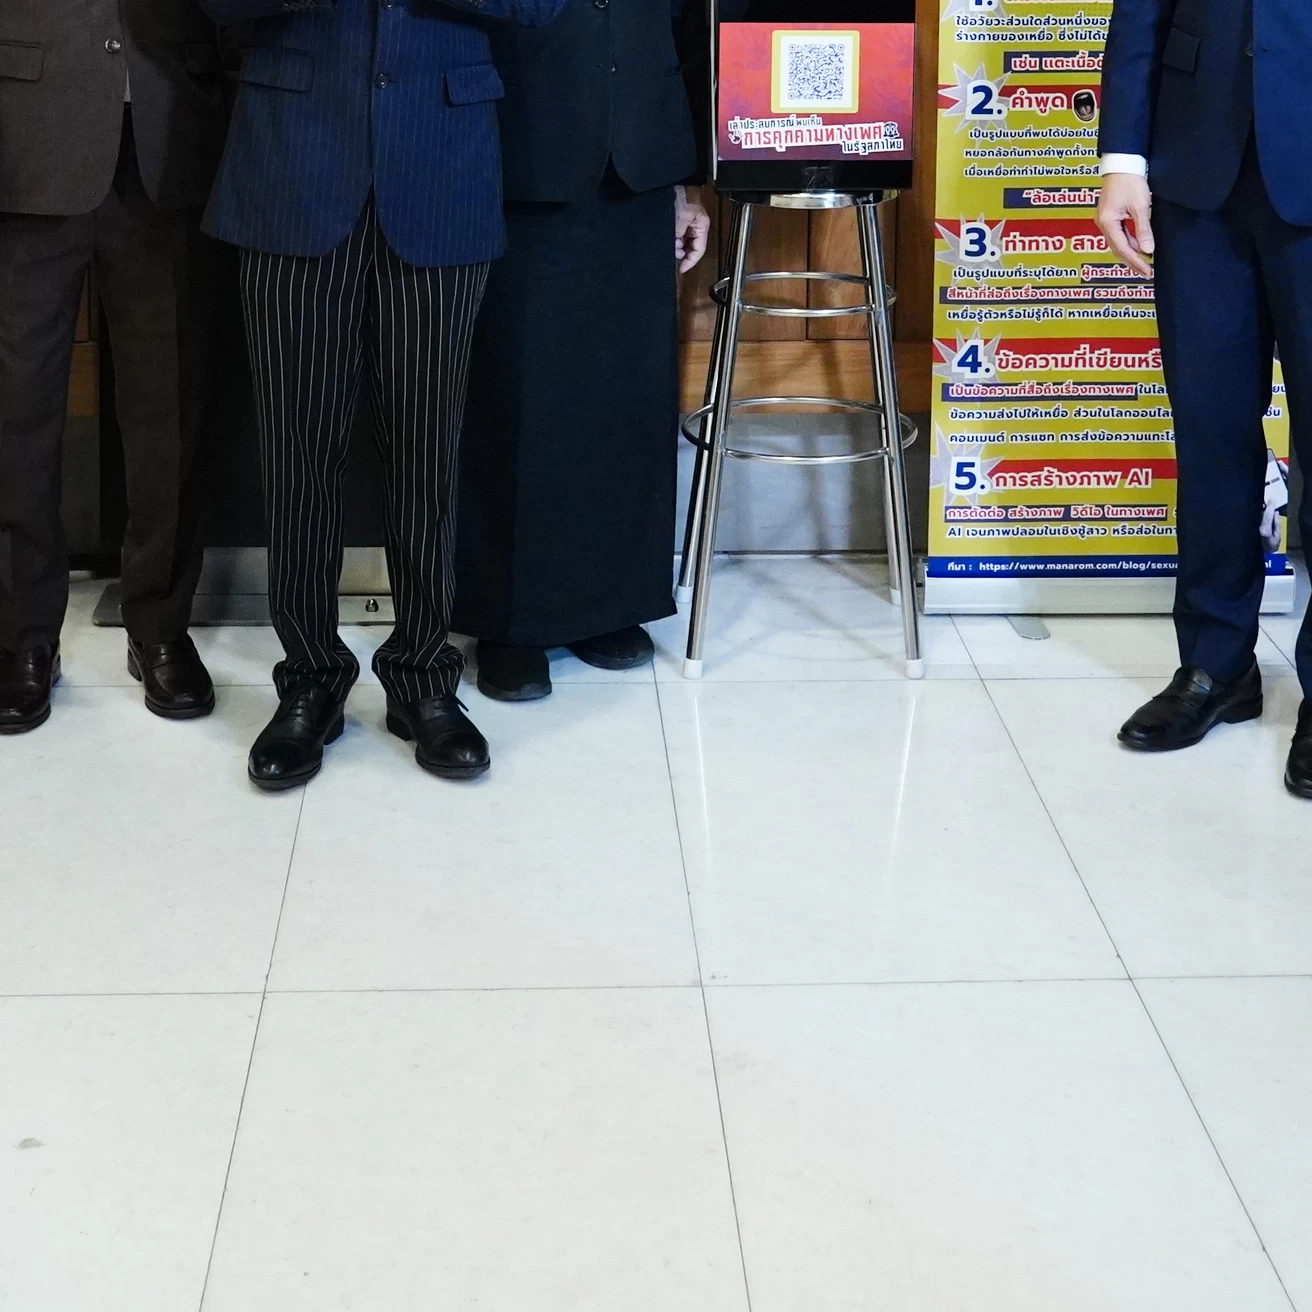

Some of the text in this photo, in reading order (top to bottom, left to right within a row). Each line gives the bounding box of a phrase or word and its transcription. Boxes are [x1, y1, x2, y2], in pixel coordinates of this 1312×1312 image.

[956, 29, 1053, 41] ร่างกายของเหยื่อ
[1013, 55, 1038, 69] เช่น
[971, 85, 1065, 115] 2. คำพูด
[743, 124, 882, 149] การคุกคามทางเพศ
[843, 138, 902, 154] ในรัฐสภาไทย
[964, 228, 996, 257] 3.
[1004, 233, 1064, 252] ท่าทาง
[953, 265, 1077, 280] เป็นรูปแบบที่ระบุได้ยาก
[957, 344, 991, 374] 4.
[950, 404, 1068, 419] ข้อความส่งไปให้เหยื่อ
[950, 431, 1005, 443] คอมเมนต์
[1010, 433, 1055, 442] การแชท
[954, 461, 1150, 490] 5. การสร้างภาพ AI
[947, 506, 1005, 519] การตัดต่อ
[1009, 505, 1063, 518] สร้างภาพ
[1072, 505, 1102, 517] วิดีโอ
[1106, 505, 1165, 517] ในทางเพศ
[948, 527, 961, 536] AI
